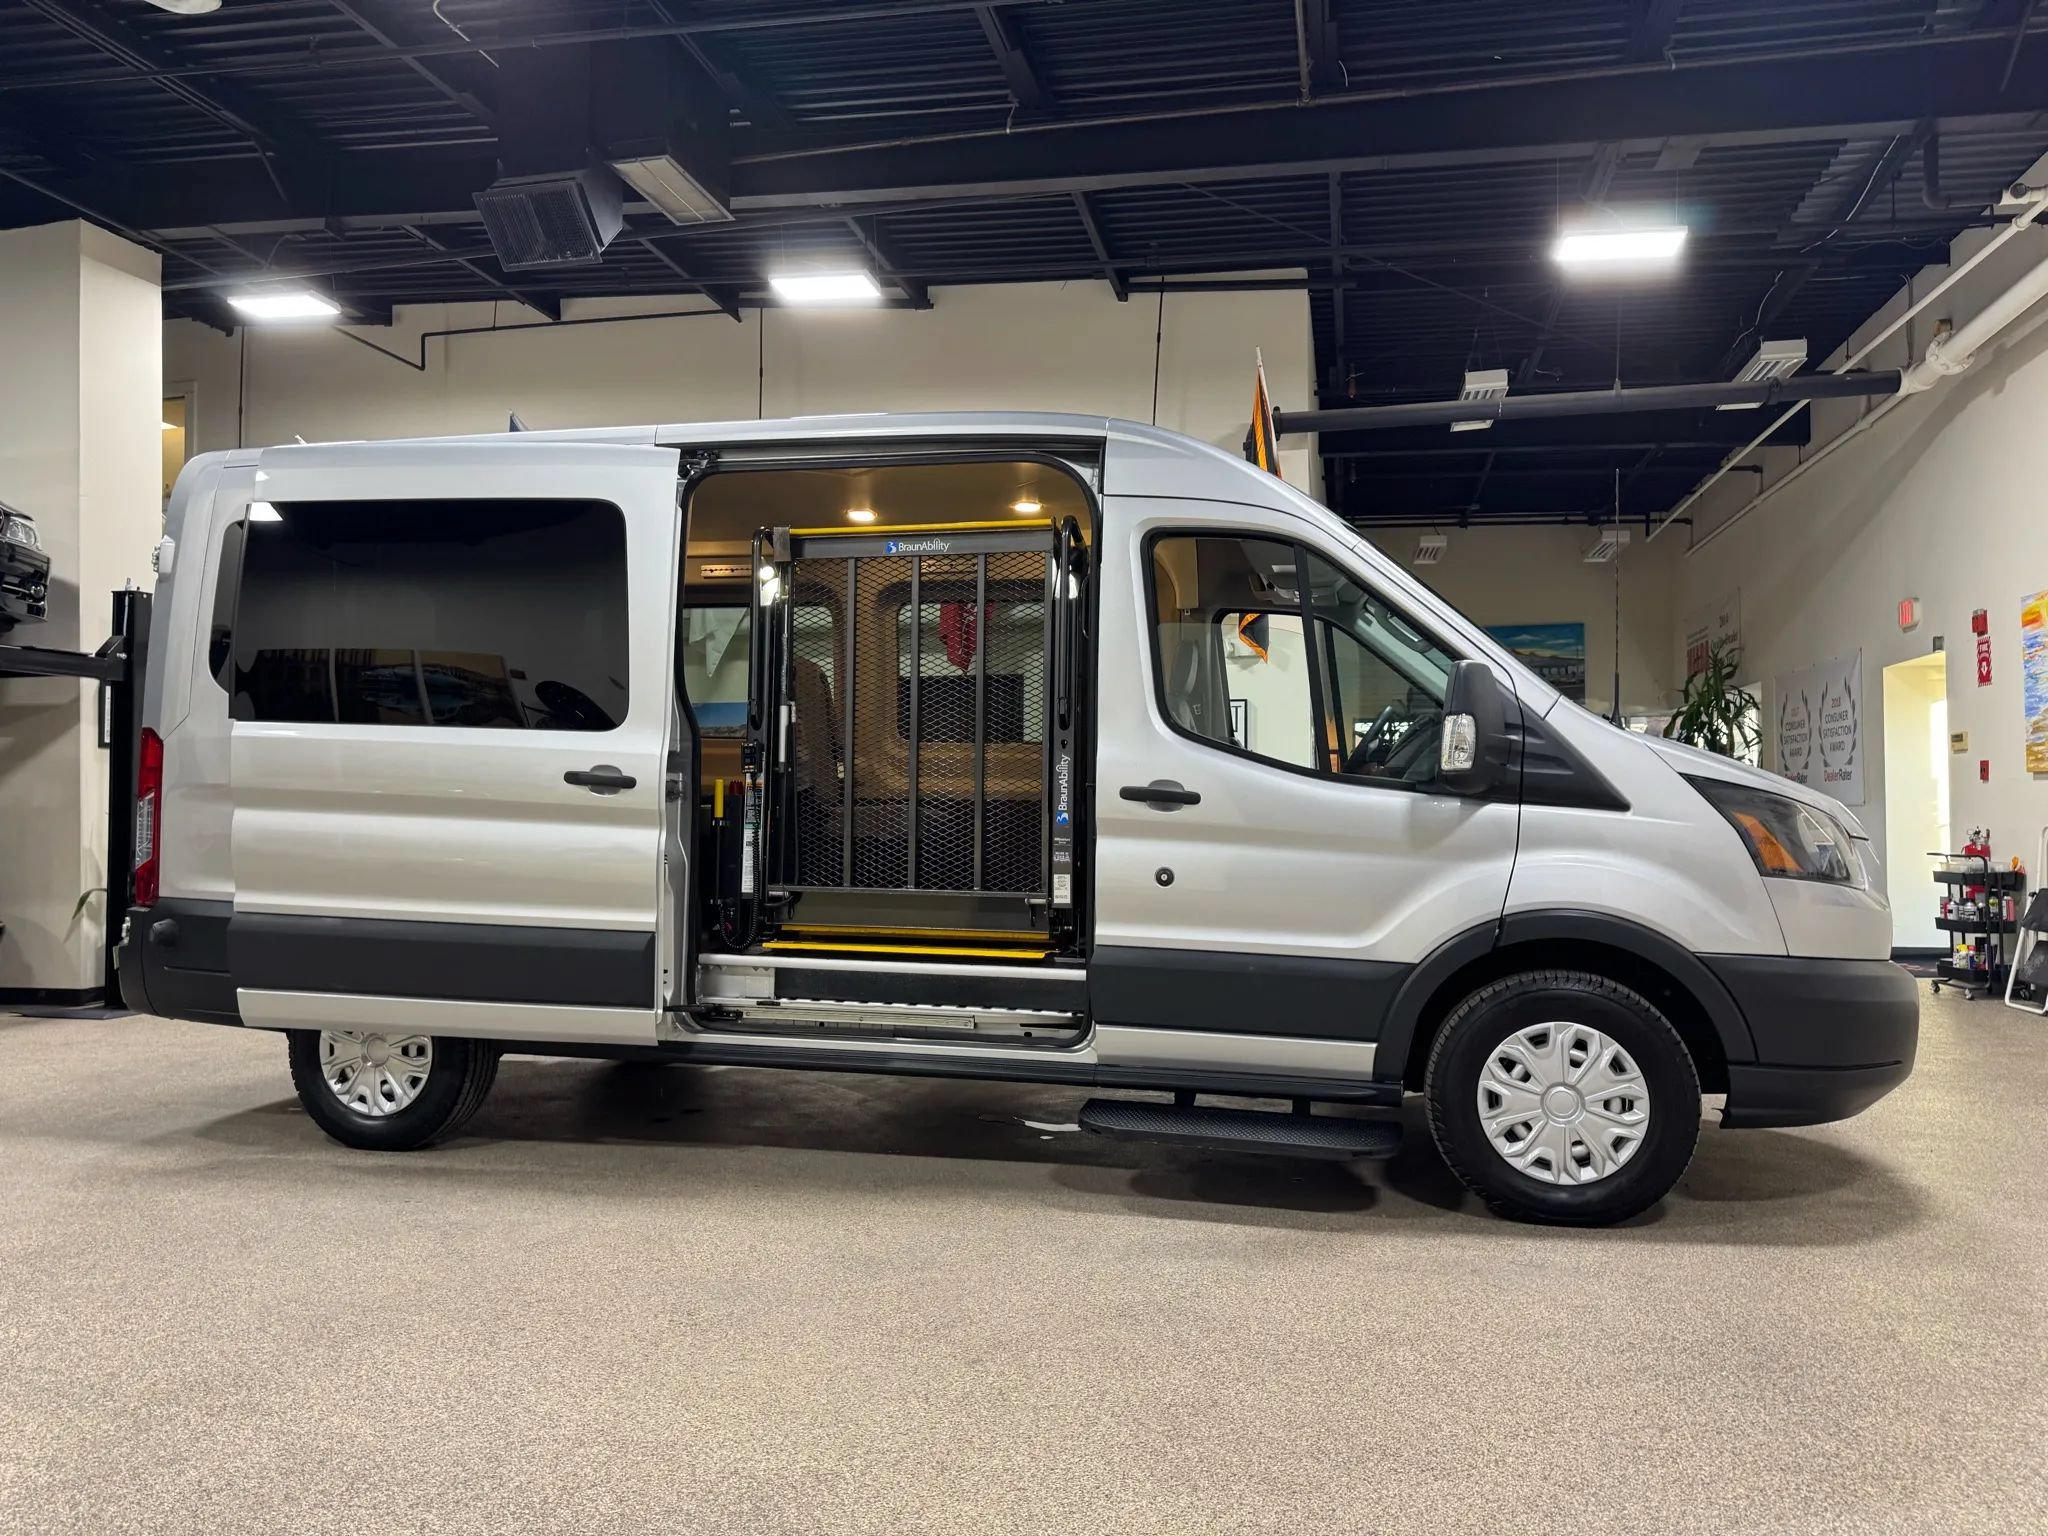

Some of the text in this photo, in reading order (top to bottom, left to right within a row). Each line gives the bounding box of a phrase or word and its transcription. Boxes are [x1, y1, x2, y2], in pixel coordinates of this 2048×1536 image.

[898, 538, 950, 553] BraunAbility
[1824, 710, 1849, 724] CONSUMER
[1056, 753, 1070, 811] BraunAbility
[1824, 769, 1853, 782] DealerRater
